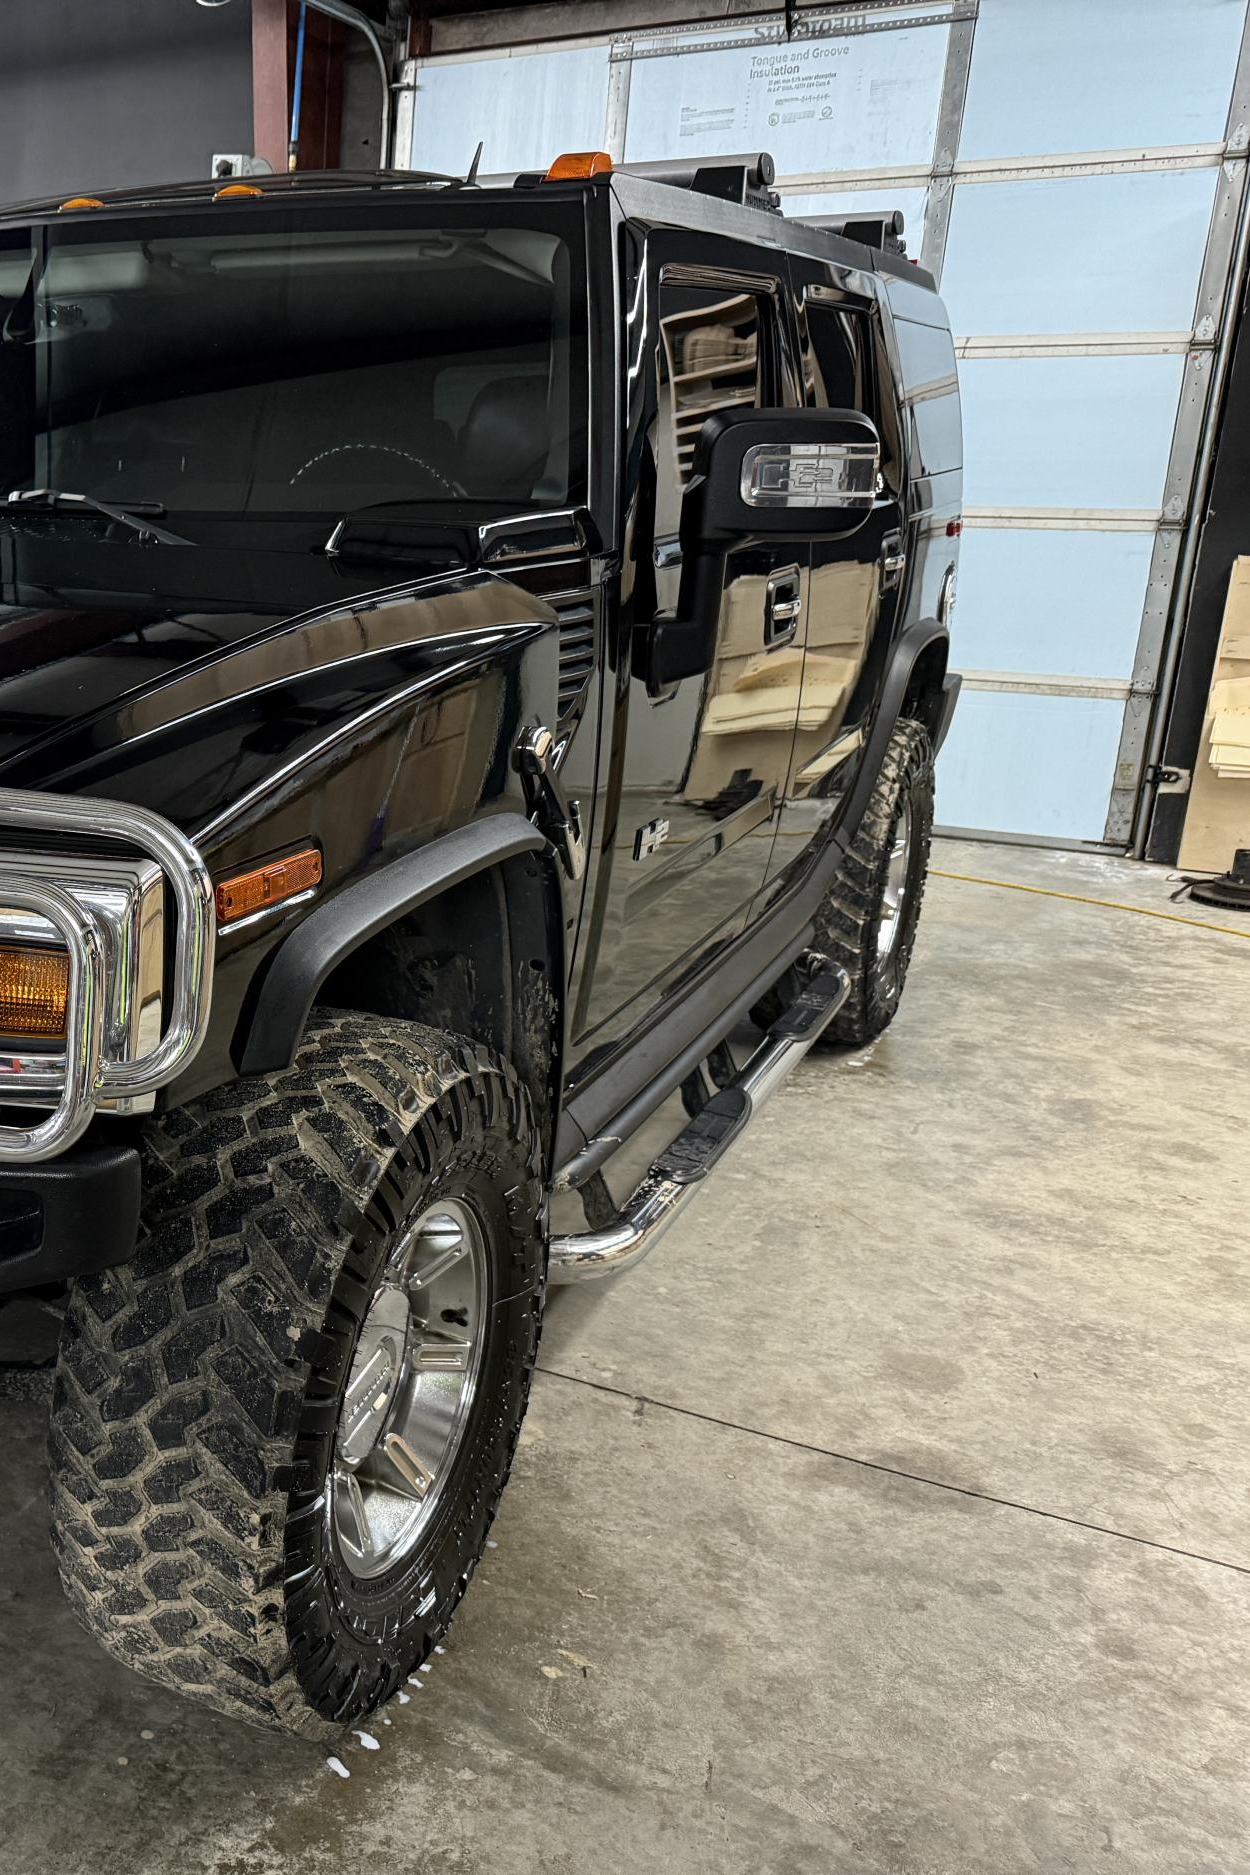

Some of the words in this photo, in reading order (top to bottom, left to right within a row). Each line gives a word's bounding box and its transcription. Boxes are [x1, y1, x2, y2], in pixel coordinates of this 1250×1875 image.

[750, 53, 788, 68] Tongue
[790, 49, 810, 61] and
[812, 45, 850, 59] Groove
[750, 65, 800, 79] Insulation
